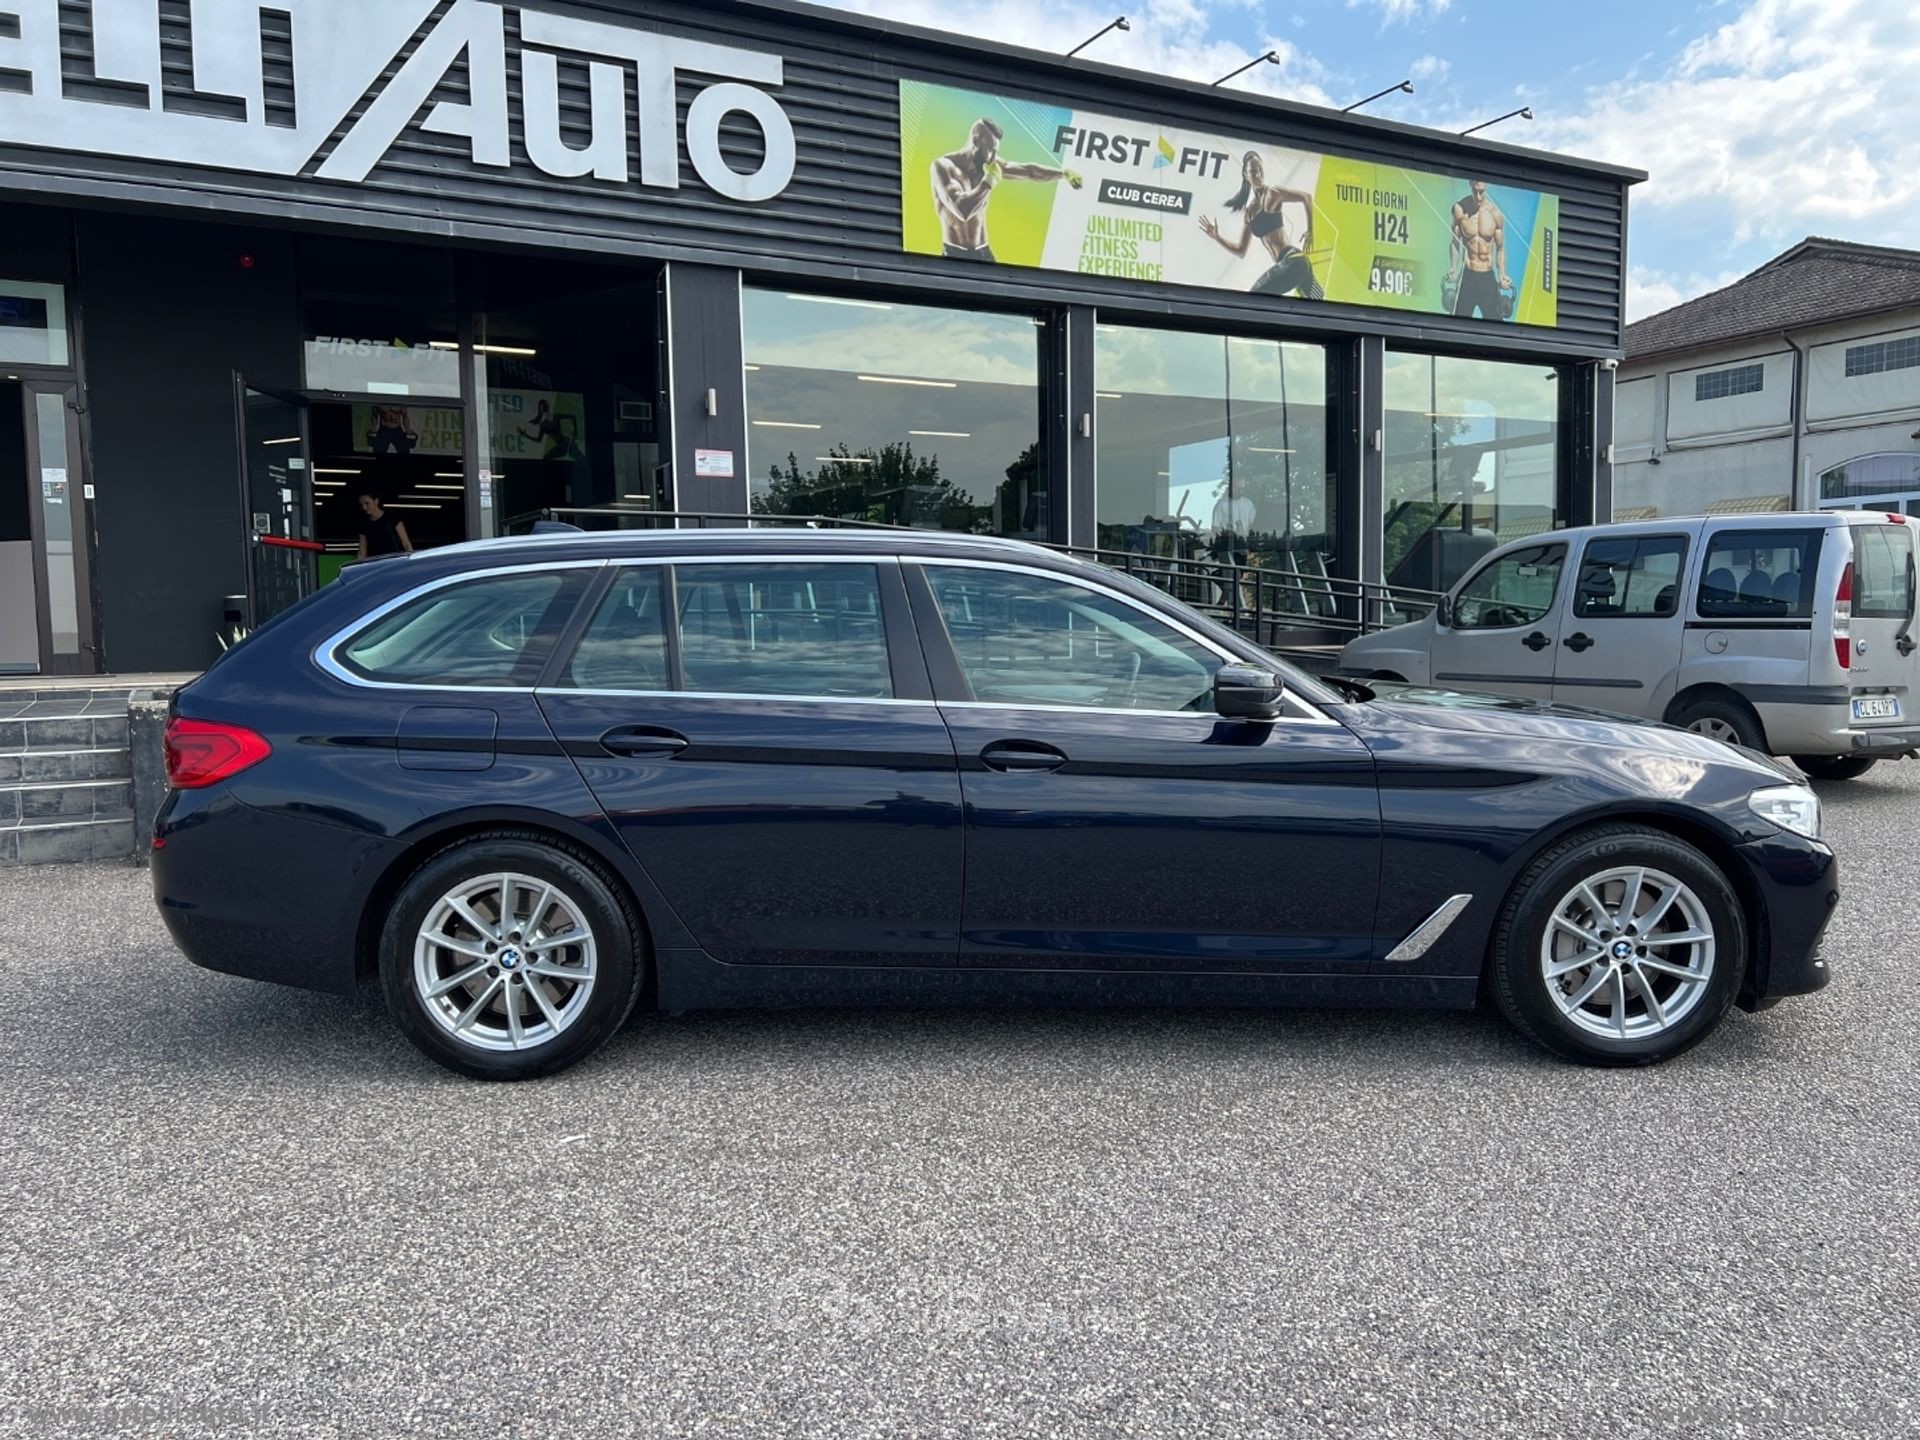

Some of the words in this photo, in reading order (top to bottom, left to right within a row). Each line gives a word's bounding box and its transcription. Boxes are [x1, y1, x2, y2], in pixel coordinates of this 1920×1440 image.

[1053, 125, 1150, 167] FIRST
[1178, 147, 1229, 179] FIT
[1107, 186, 1140, 202] CLUB
[1142, 192, 1184, 209] CEREA
[1336, 184, 1363, 204] TUTTI
[1366, 188, 1370, 205] I
[1373, 190, 1408, 211] GIORNI
[1087, 215, 1162, 242] UNLIMITED
[1374, 211, 1409, 245] H24
[1082, 235, 1138, 260] FITNESS
[1078, 255, 1163, 282] EXPERIENCE
[1371, 267, 1413, 297] 9.90€
[312, 336, 389, 357] FIRST
[412, 343, 450, 361] FIT
